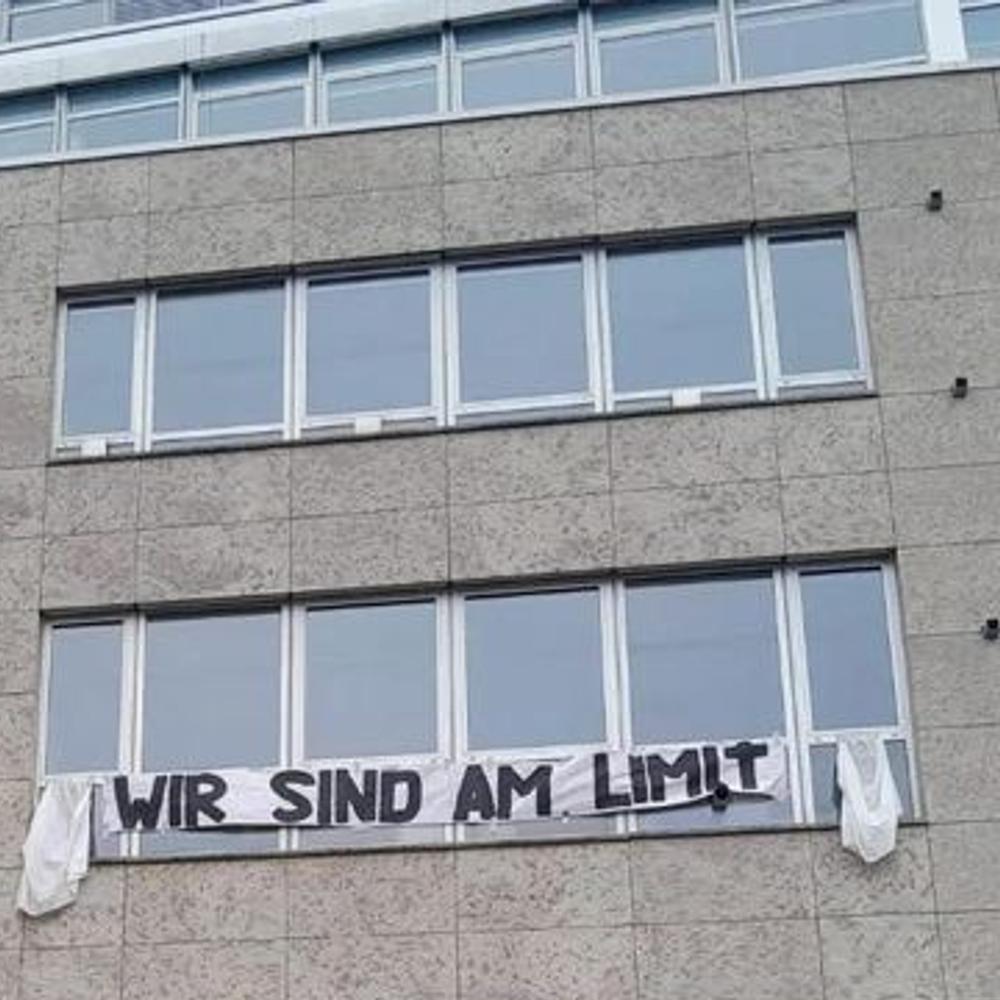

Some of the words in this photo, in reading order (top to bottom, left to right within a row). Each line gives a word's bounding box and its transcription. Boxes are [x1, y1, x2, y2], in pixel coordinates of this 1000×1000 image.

[114, 773, 227, 829] WIR
[271, 769, 422, 824] SIND
[453, 764, 552, 821] AM
[593, 742, 767, 810] LIMIT
